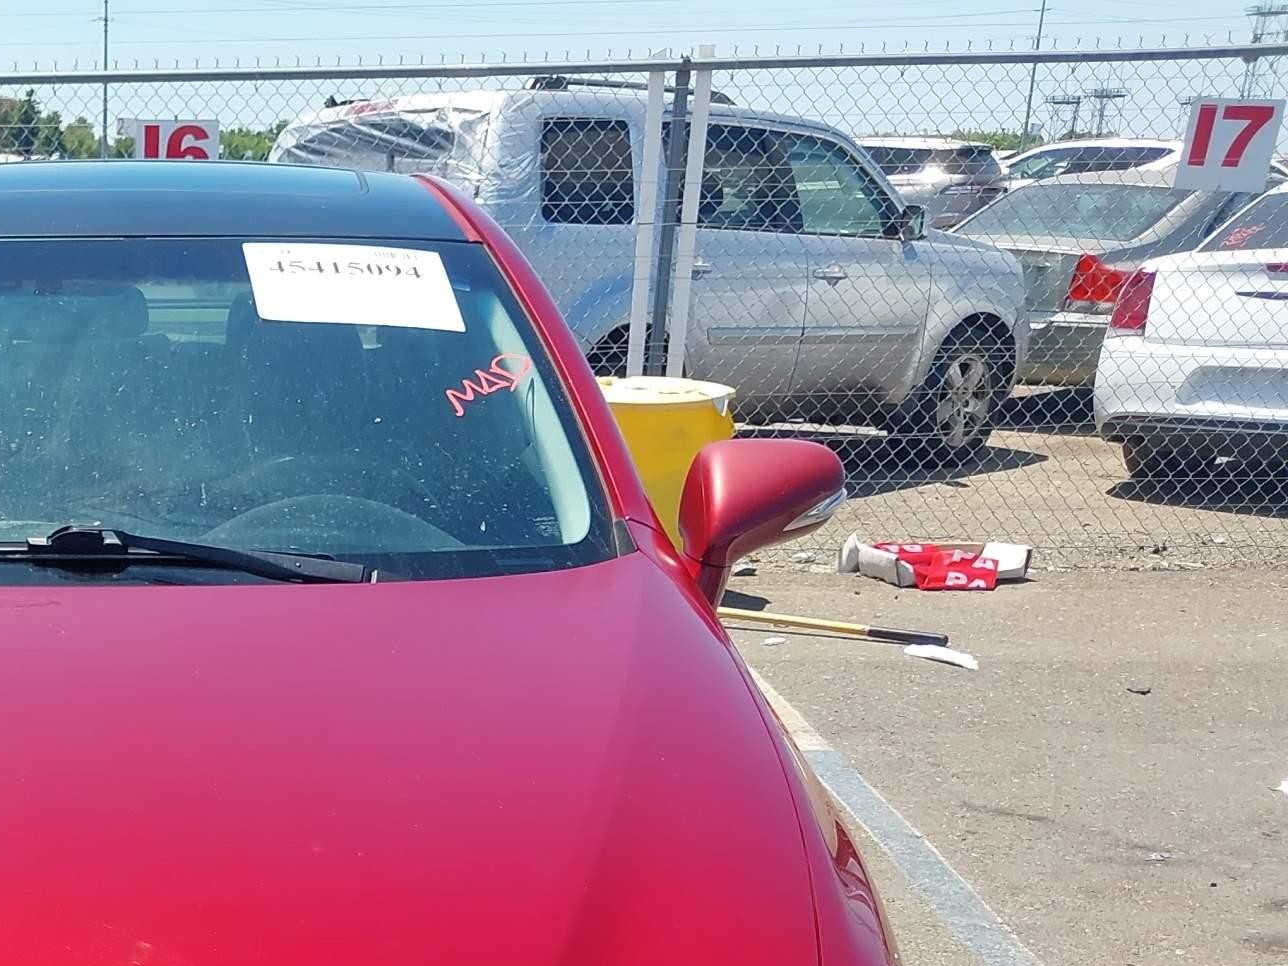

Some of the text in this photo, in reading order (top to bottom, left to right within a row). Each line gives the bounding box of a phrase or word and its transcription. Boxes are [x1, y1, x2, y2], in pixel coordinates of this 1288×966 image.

[143, 124, 210, 159] 16
[1187, 103, 1275, 168] 17
[269, 260, 424, 279] 45415094
